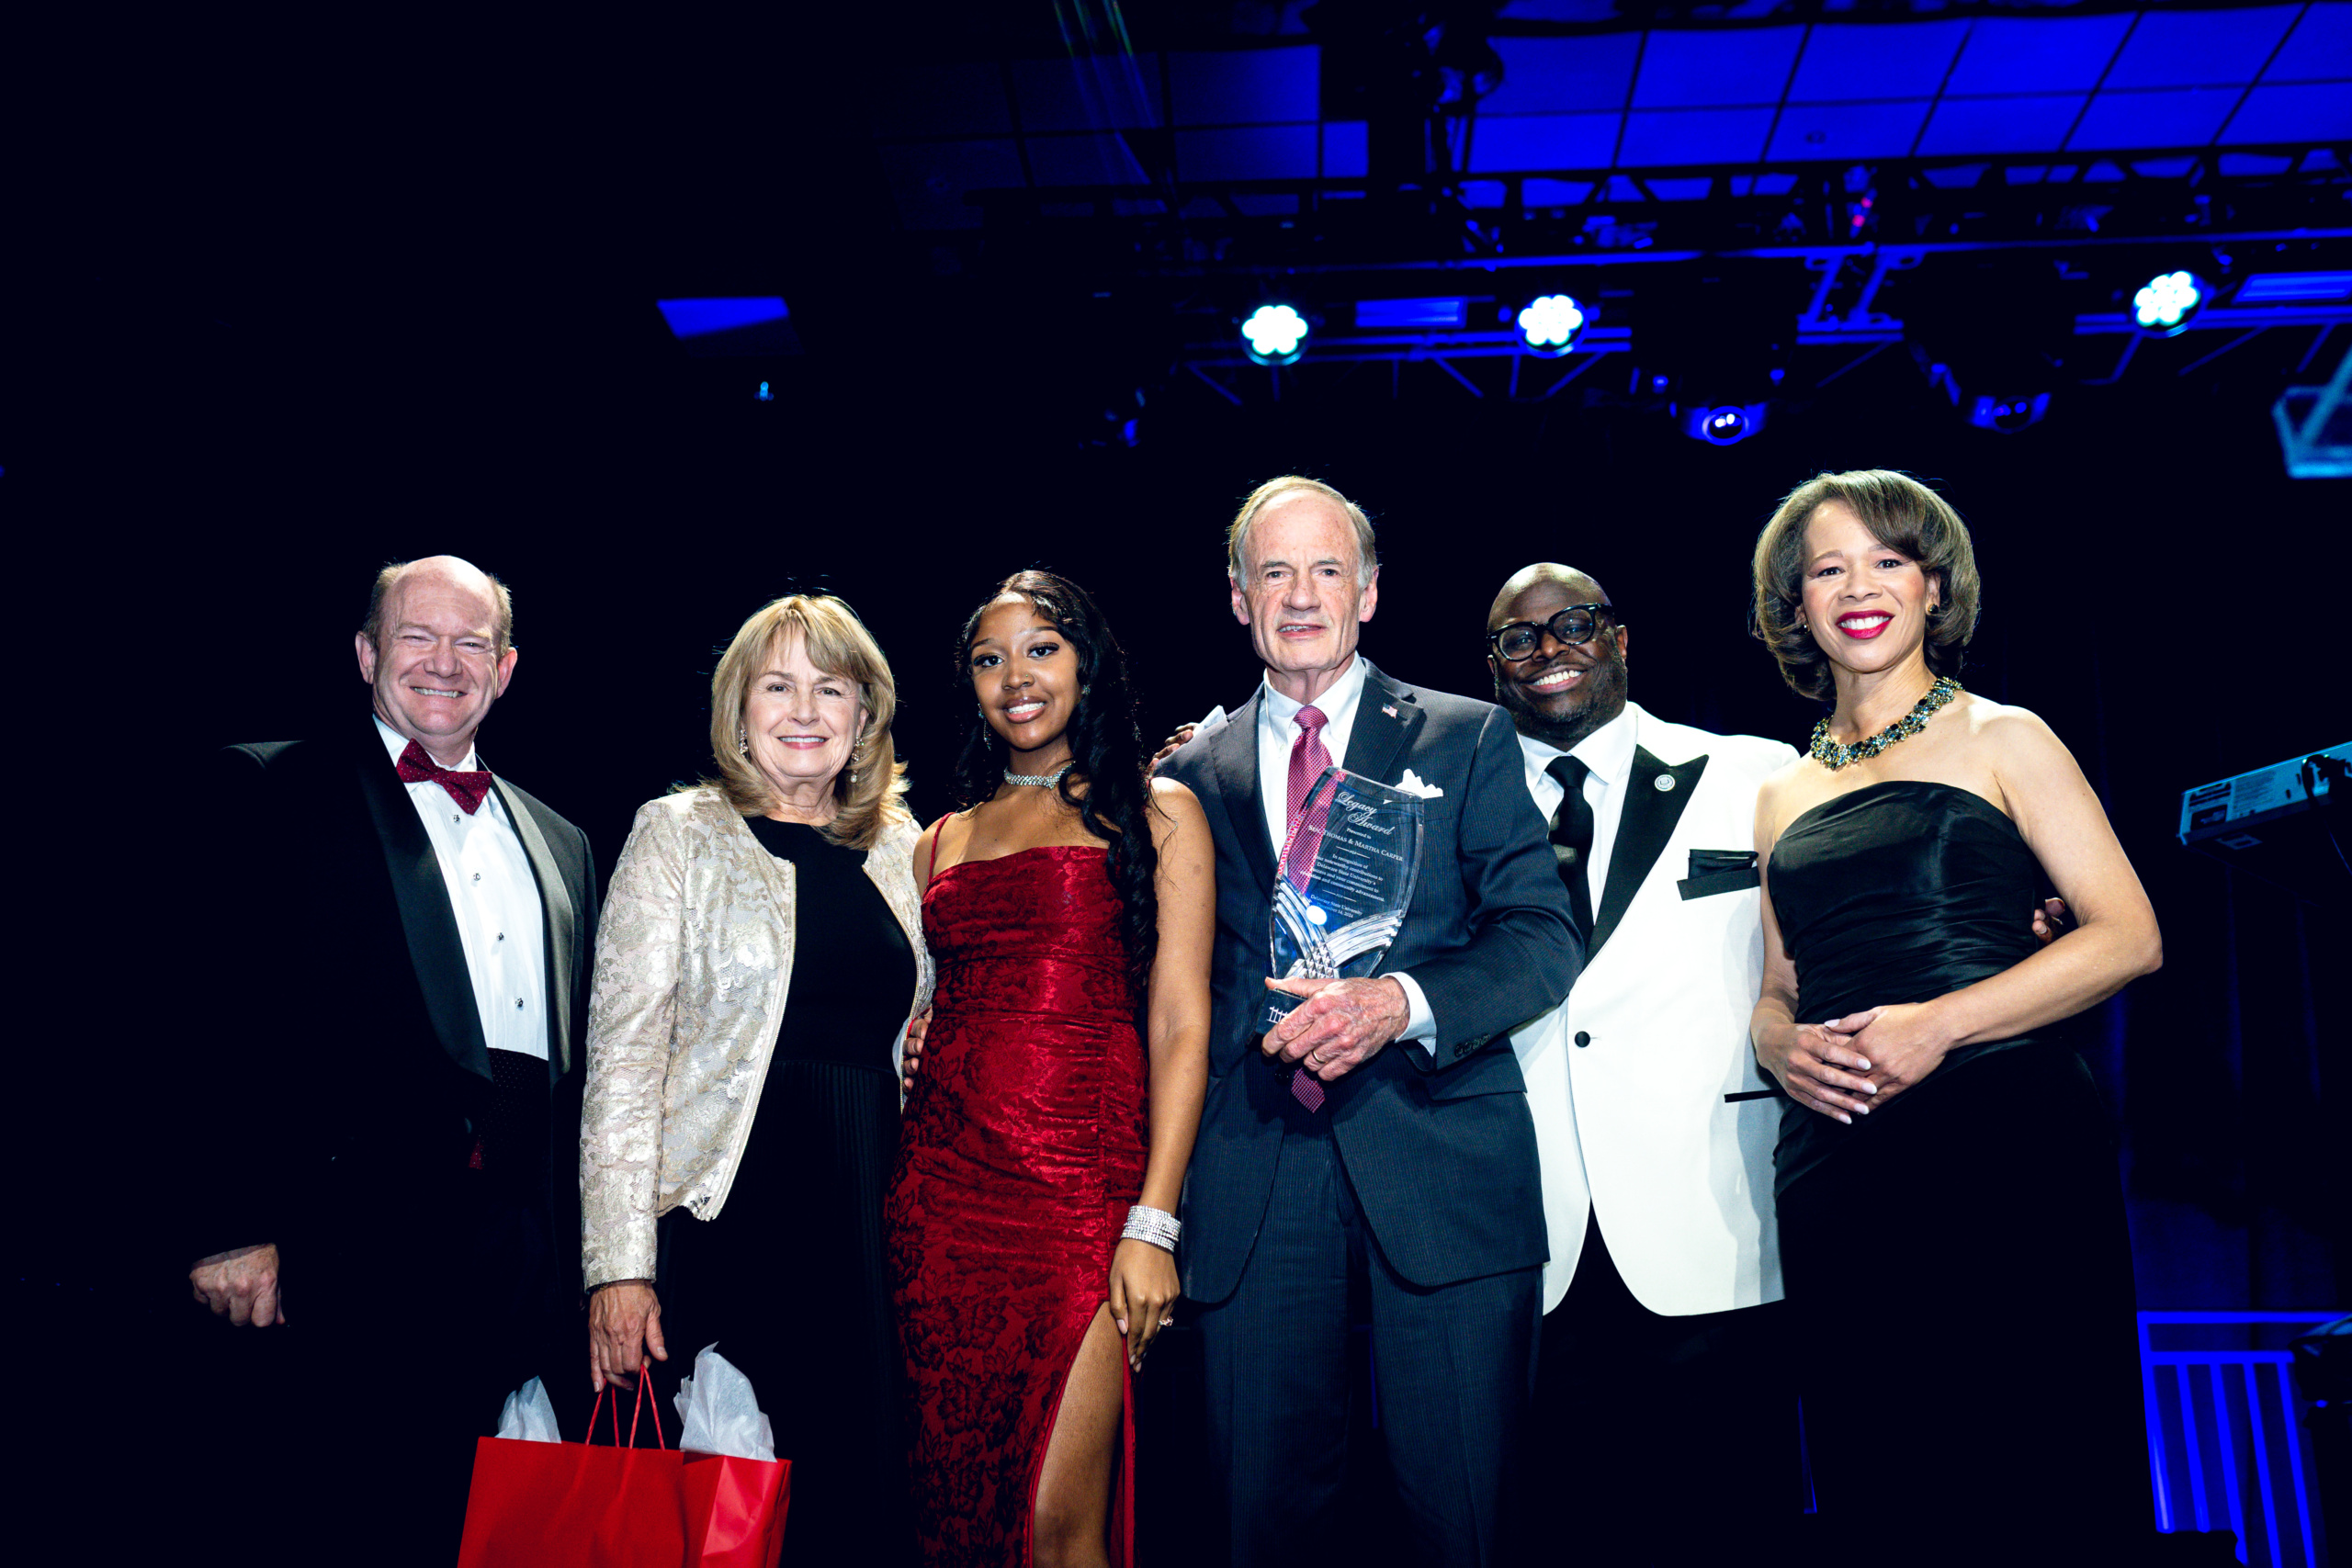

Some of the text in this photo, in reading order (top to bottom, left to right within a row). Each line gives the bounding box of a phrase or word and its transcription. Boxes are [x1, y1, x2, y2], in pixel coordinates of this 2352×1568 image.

[1338, 791, 1377, 817] Legacy
[1348, 812, 1396, 835] Award
[1346, 828, 1367, 838] Presented
[1354, 840, 1380, 854] MARTHA
[1317, 862, 1338, 873] Delaware
[1338, 856, 1363, 867] recognition
[1349, 867, 1378, 880] contributions
[1330, 880, 1355, 892] community
[1346, 879, 1374, 891] commitment
[1310, 894, 1330, 905] Delaware
[1341, 904, 1363, 916] University
